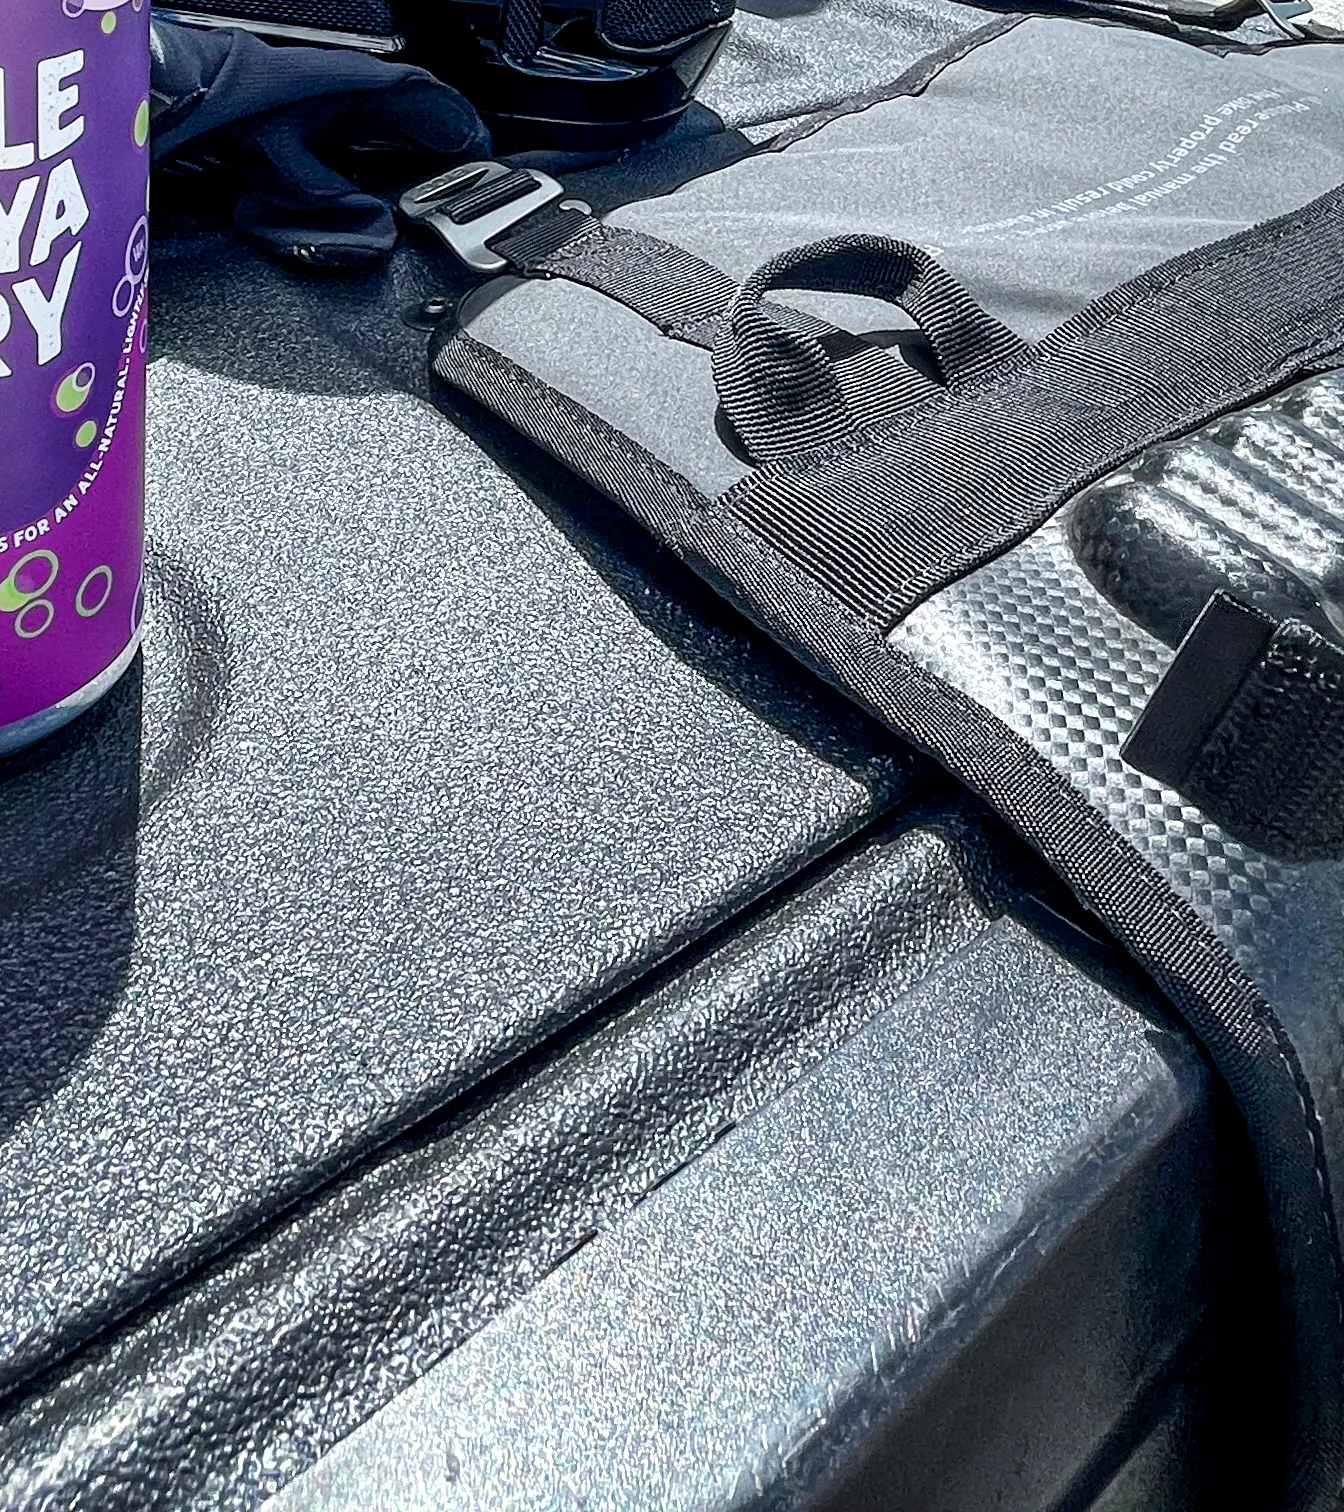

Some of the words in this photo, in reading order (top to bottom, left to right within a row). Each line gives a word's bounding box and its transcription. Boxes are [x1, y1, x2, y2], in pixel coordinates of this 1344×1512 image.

[1149, 114, 1223, 173] properly
[1218, 118, 1259, 154] read
[1190, 152, 1227, 174] the
[1107, 169, 1156, 193] could
[1128, 172, 1197, 206] manual
[1051, 186, 1110, 212] result
[14, 519, 50, 547] FOR
[54, 494, 79, 523] AN
